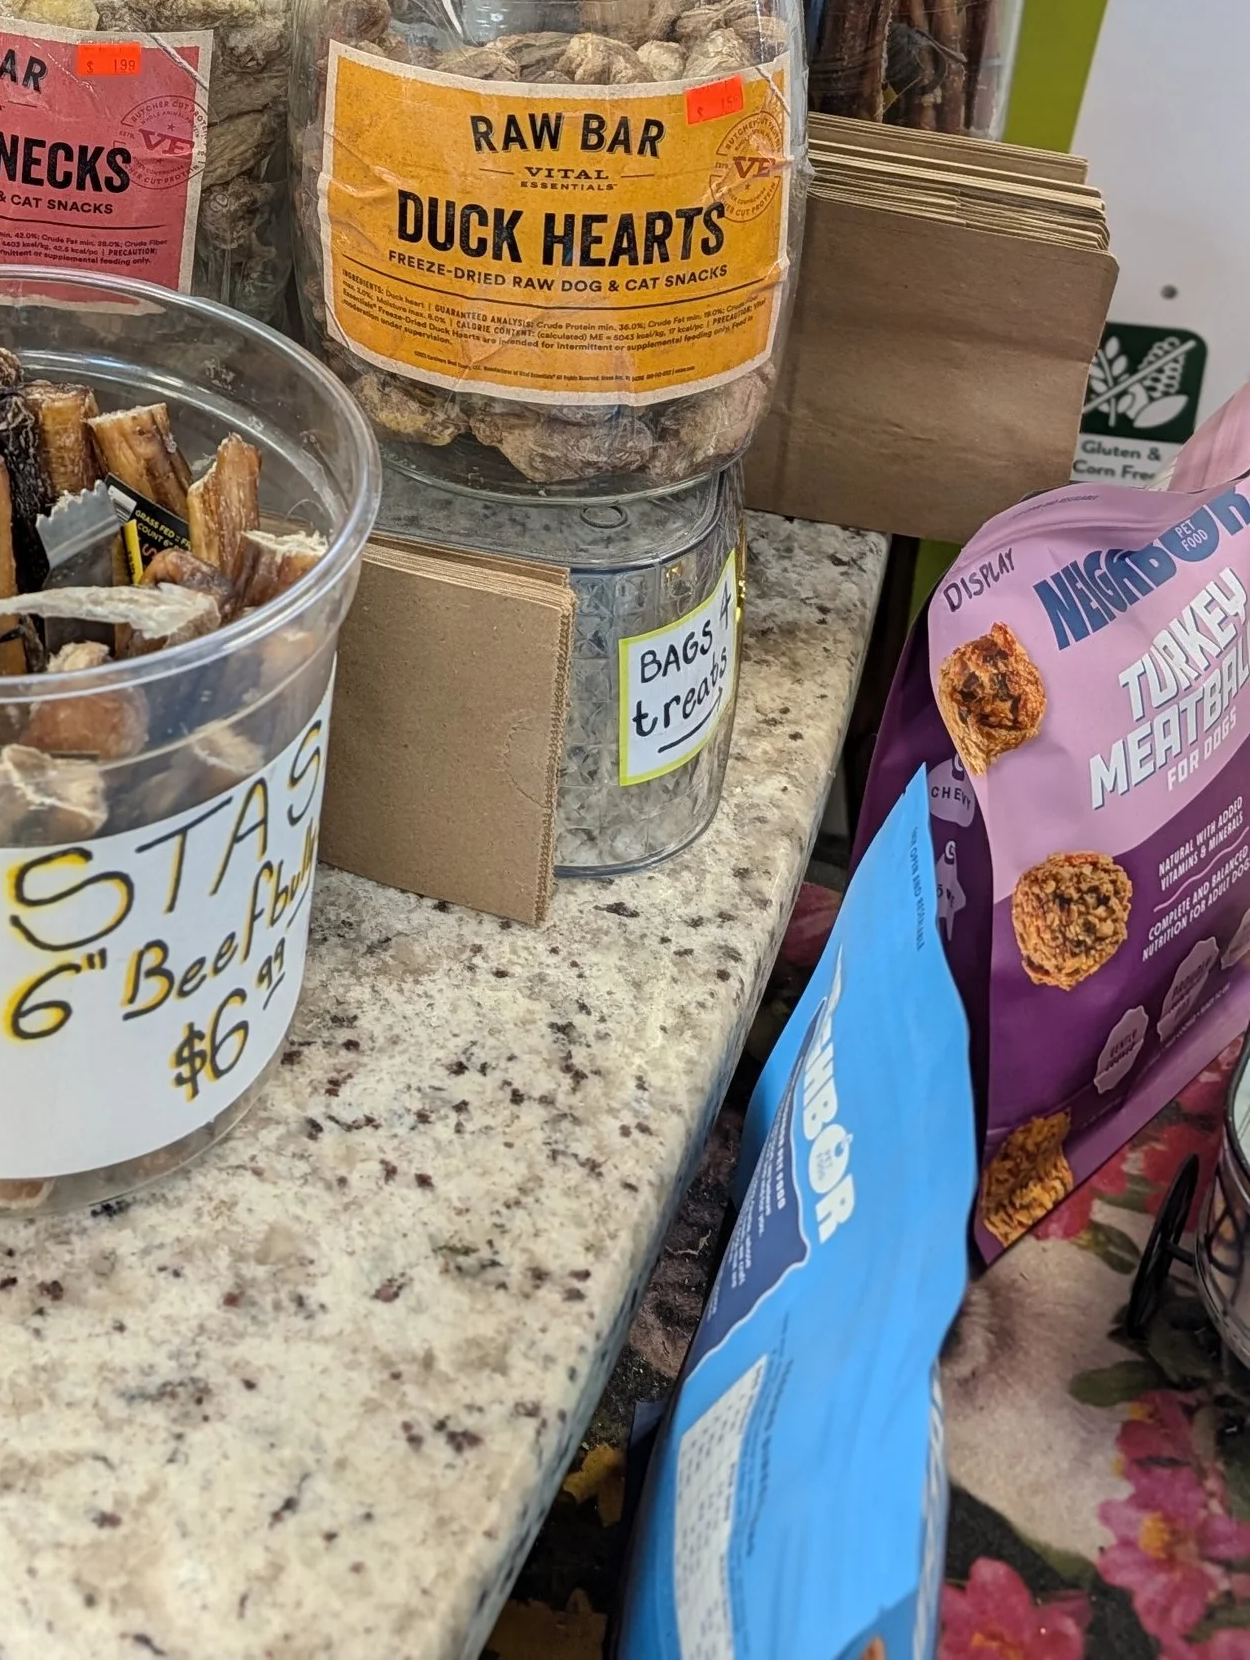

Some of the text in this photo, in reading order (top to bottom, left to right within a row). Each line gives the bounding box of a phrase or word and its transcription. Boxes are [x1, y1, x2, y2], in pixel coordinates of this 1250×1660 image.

[470, 112, 666, 158] RAW BAR
[524, 166, 609, 181] VITAL
[11, 194, 42, 208] CAT
[47, 199, 114, 215] SNACKS
[396, 188, 726, 268] DUCK HEARTS
[388, 250, 728, 292] FREEZE-DRIED RAW DOG & CAT SNACKS
[434, 304, 488, 322] GUARANTEED
[491, 315, 534, 328] ANALYSIS:
[536, 321, 563, 330] Crude
[565, 322, 596, 331] Protein
[648, 317, 671, 328] Crude
[456, 321, 491, 334] CALORIE
[556, 342, 613, 352] intermittent
[627, 335, 683, 352] supplemental
[1072, 459, 1116, 478] Corn
[1081, 440, 1162, 462] Gluten &
[135, 509, 176, 539] GRASS FED
[137, 523, 164, 543] COUNT
[1174, 519, 1196, 539] PET
[1181, 528, 1209, 552] FOOD
[943, 547, 1015, 613] DISPLAY
[640, 619, 713, 684] BAGS
[1118, 566, 1248, 721] TURKEY
[632, 646, 728, 737] treats
[1089, 622, 1250, 810] MEATBAL
[1168, 706, 1237, 791] FOR DOGS
[1158, 795, 1243, 877] NATURAL WITH ADDED
[1161, 810, 1244, 891] VITAMINS & MINERALS
[1149, 845, 1249, 940] COMPLETE AND BALANCED
[1142, 918, 1188, 962] NUTRITION
[1189, 900, 1206, 924] FOR
[1208, 877, 1230, 907] ADULT
[4, 947, 108, 1040] 6"
[122, 859, 275, 1022] Beef
